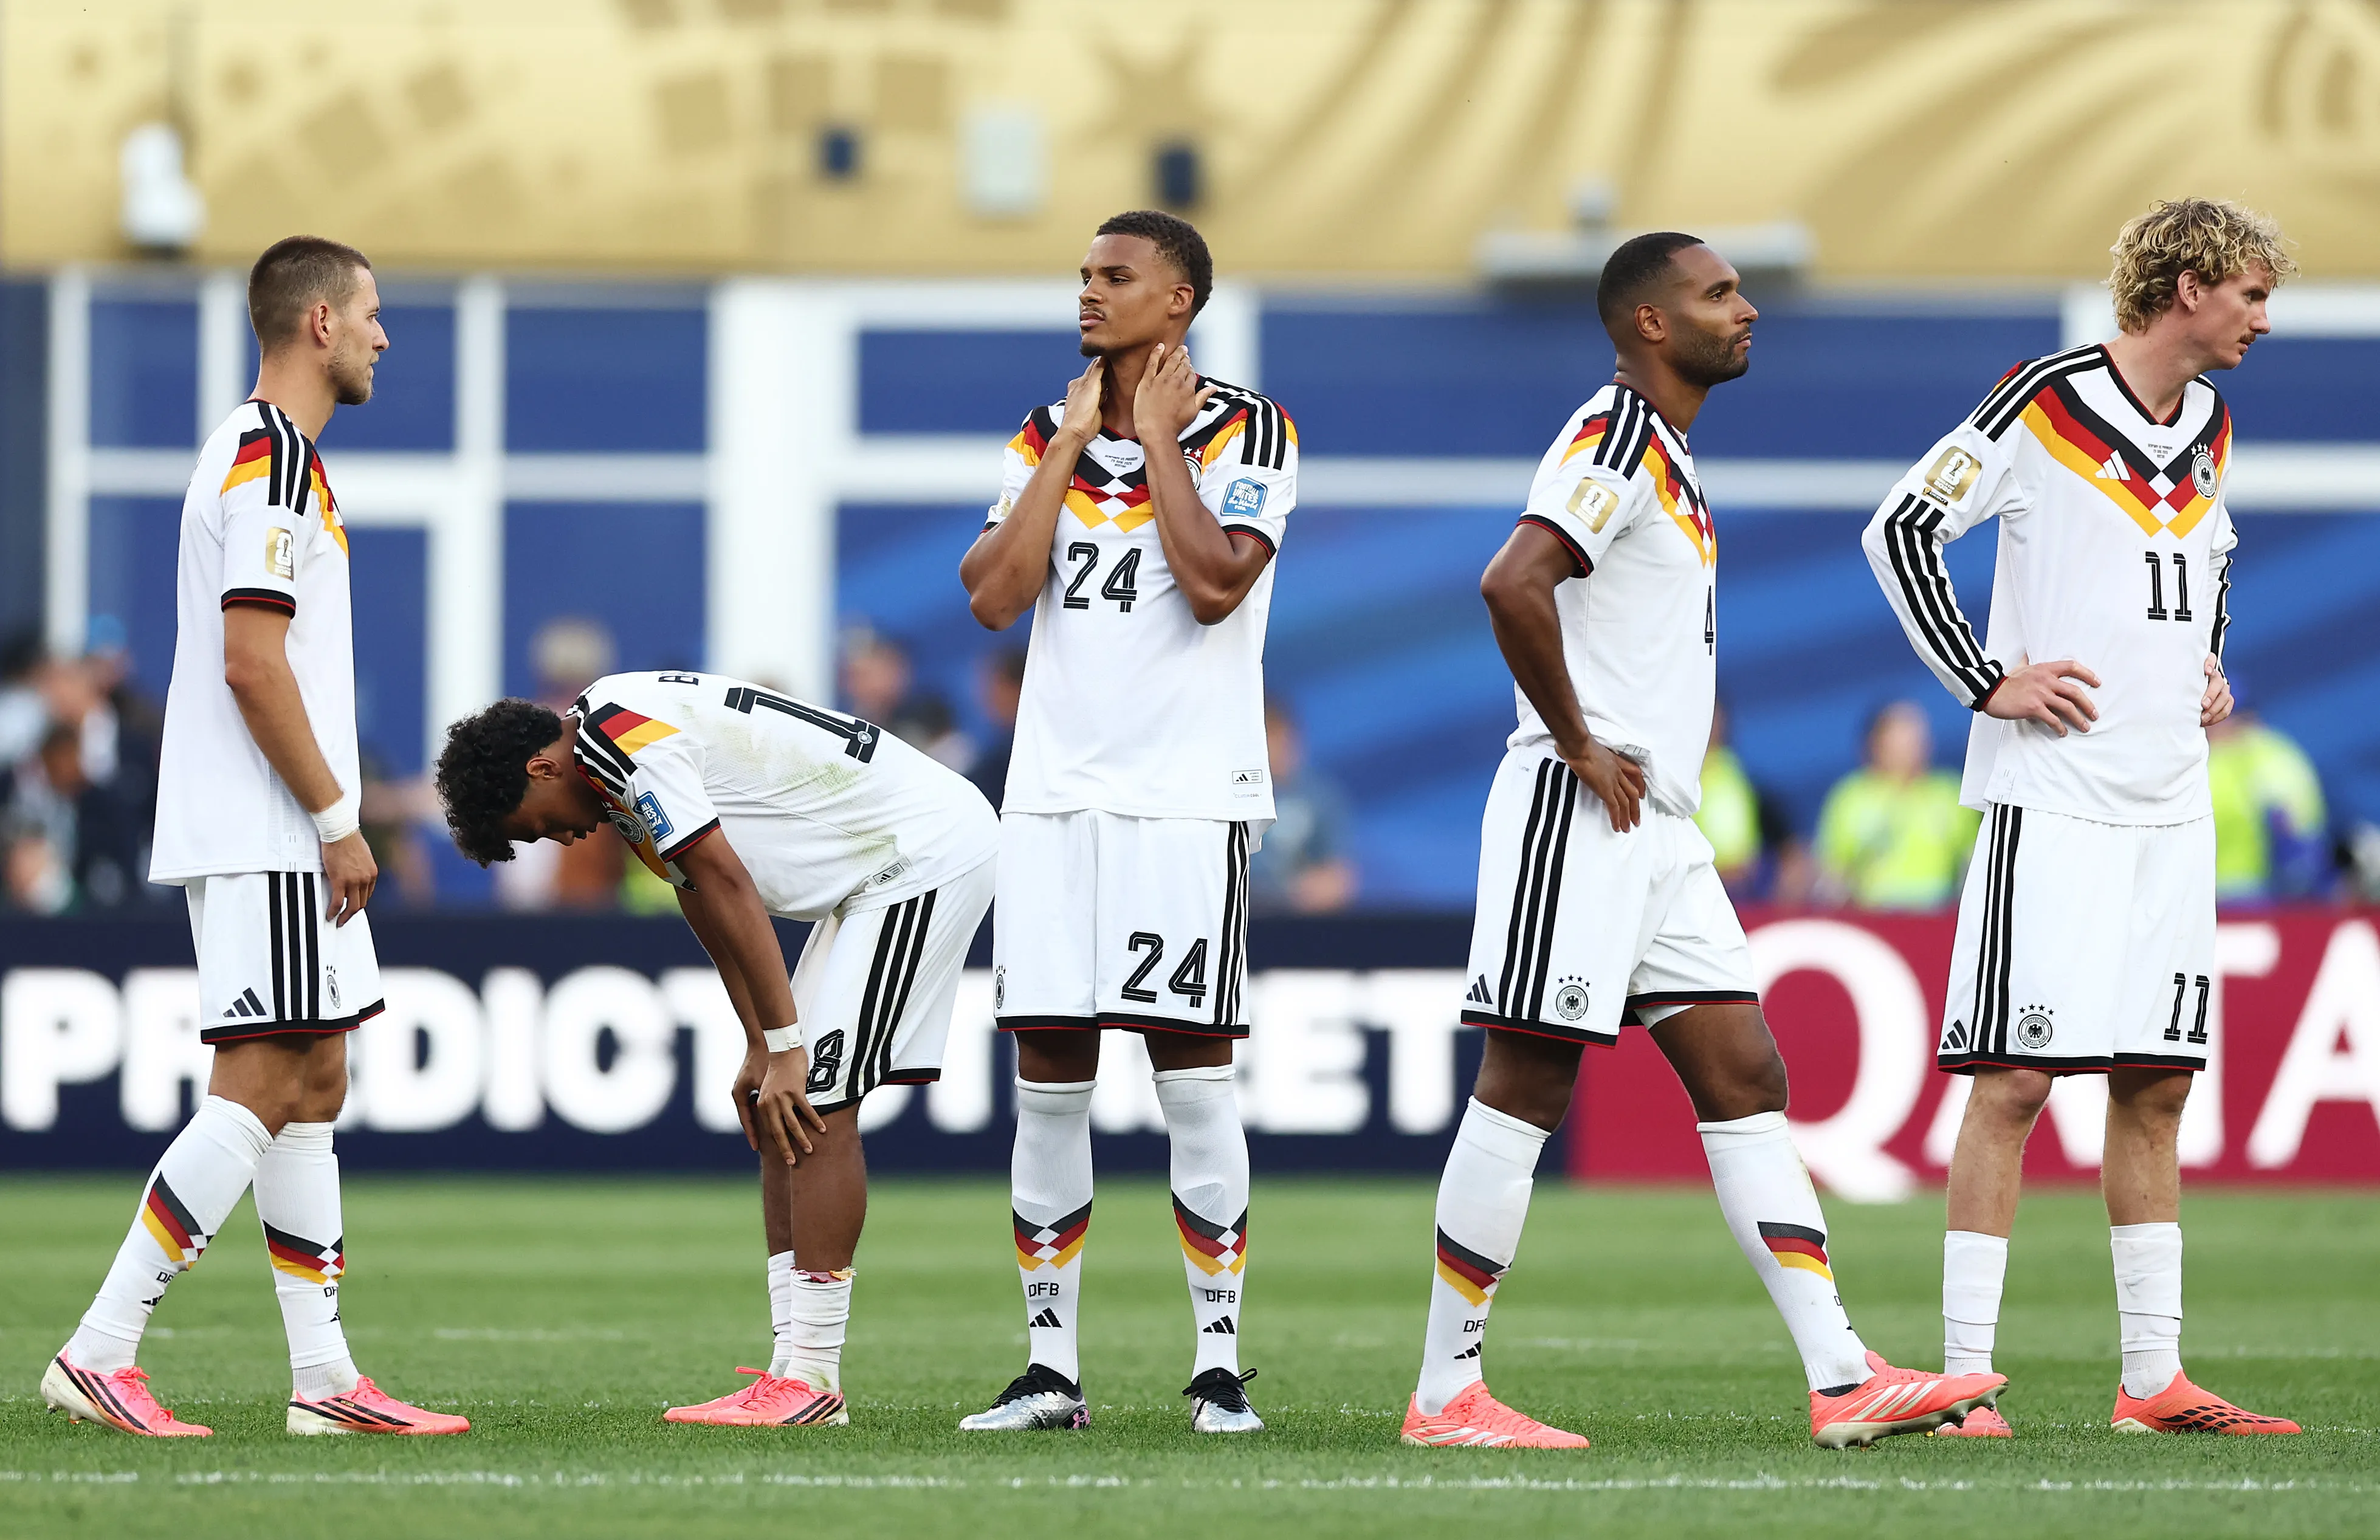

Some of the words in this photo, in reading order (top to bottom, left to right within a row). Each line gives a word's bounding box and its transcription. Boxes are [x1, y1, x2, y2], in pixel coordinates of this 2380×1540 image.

[1233, 488, 1259, 504] UNITES
[1236, 481, 1259, 497] FOOTBALL
[1063, 541, 1141, 613] 24
[2145, 552, 2192, 622] 11
[1705, 585, 1713, 655] 4
[1121, 932, 1207, 1008] 24
[2163, 973, 2209, 1044] 11
[1028, 1282, 1059, 1297] DFB
[1205, 1290, 1236, 1304] DFB
